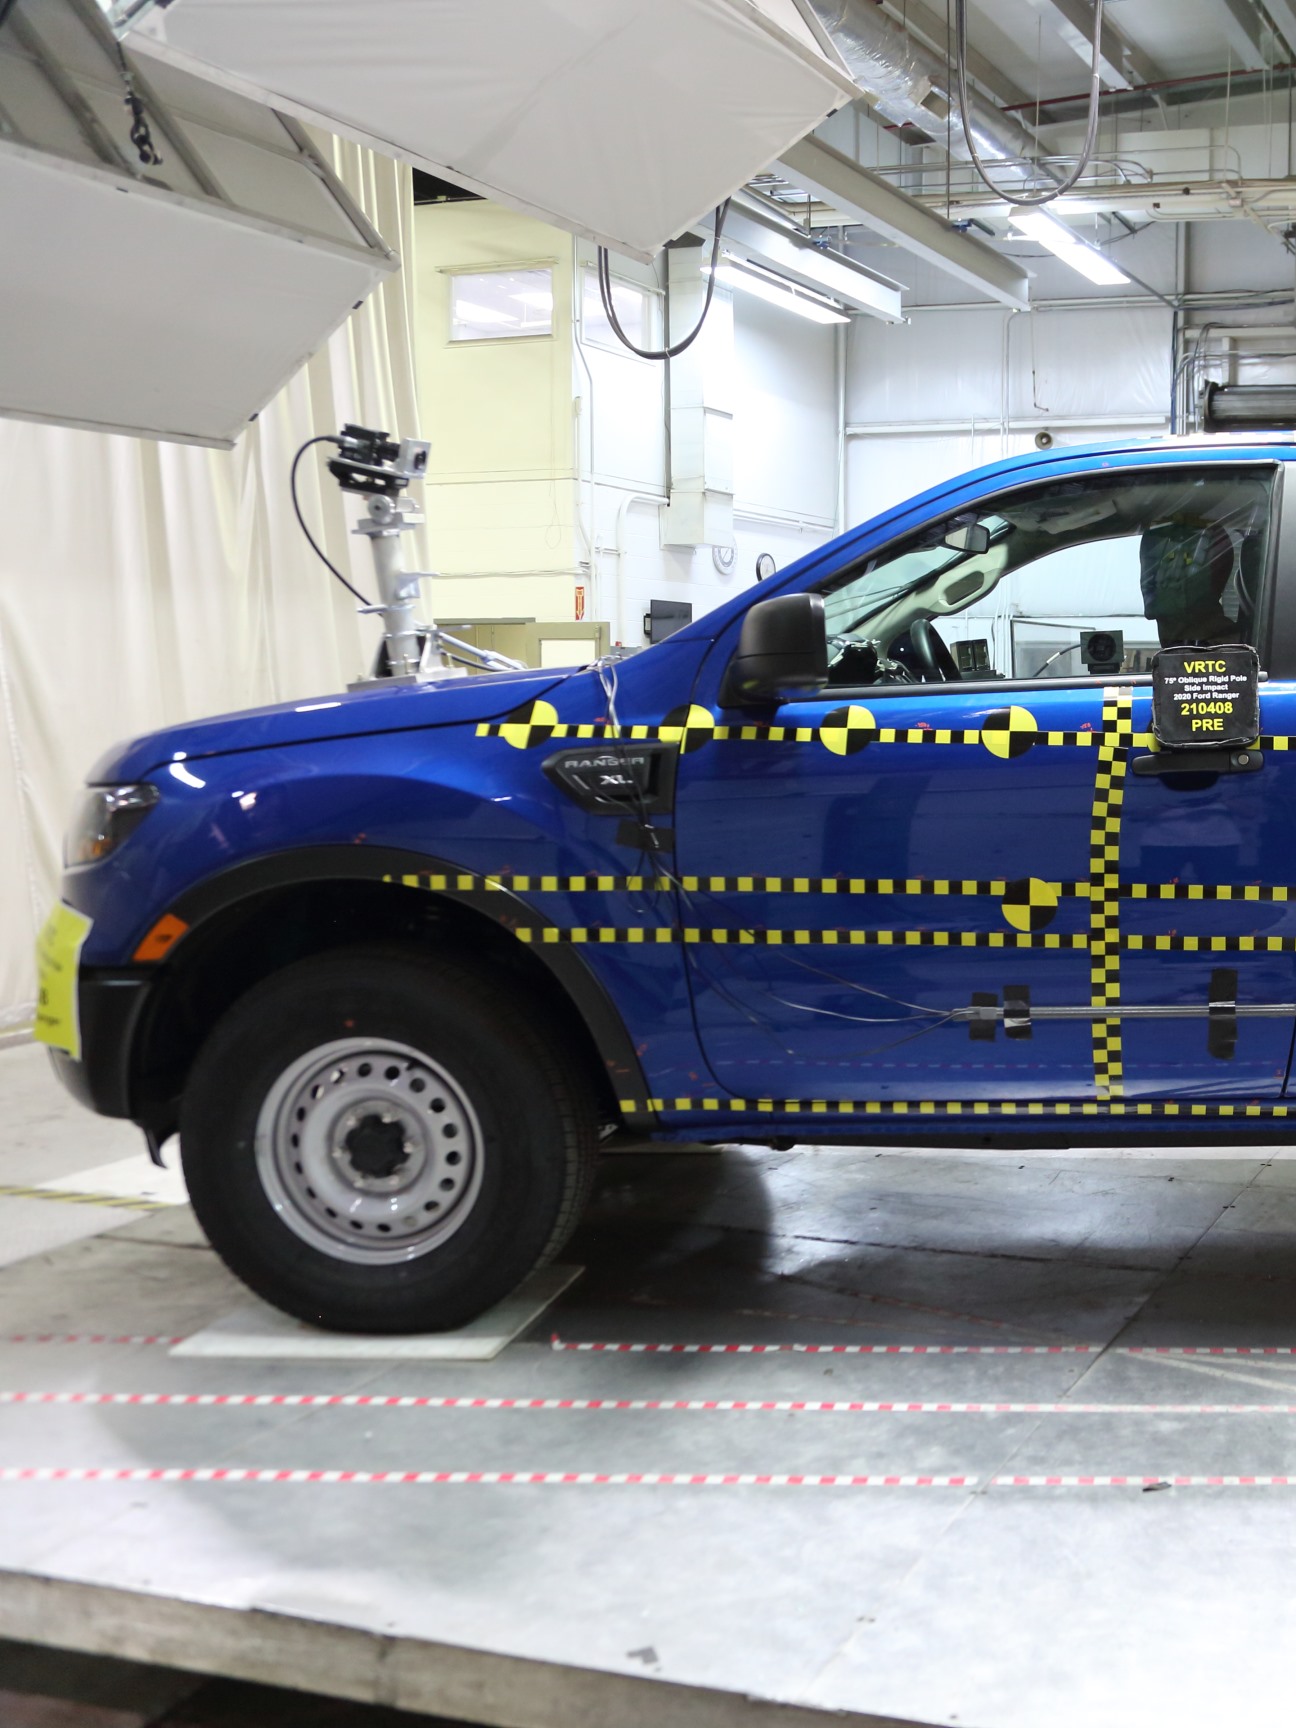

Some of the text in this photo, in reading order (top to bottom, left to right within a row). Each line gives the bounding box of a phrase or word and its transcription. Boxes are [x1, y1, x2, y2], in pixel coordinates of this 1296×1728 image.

[1183, 660, 1226, 673] VRTC
[1178, 676, 1207, 684] Oblique
[1209, 675, 1229, 683] Rigid
[1230, 674, 1247, 682] Pole
[1184, 683, 1228, 692] Side Impact
[1173, 691, 1240, 701] 2020 Ford Ranger
[1181, 702, 1233, 715] 210408
[1191, 718, 1224, 731] PRE
[565, 756, 645, 769] RANGER
[599, 774, 633, 785] XL
